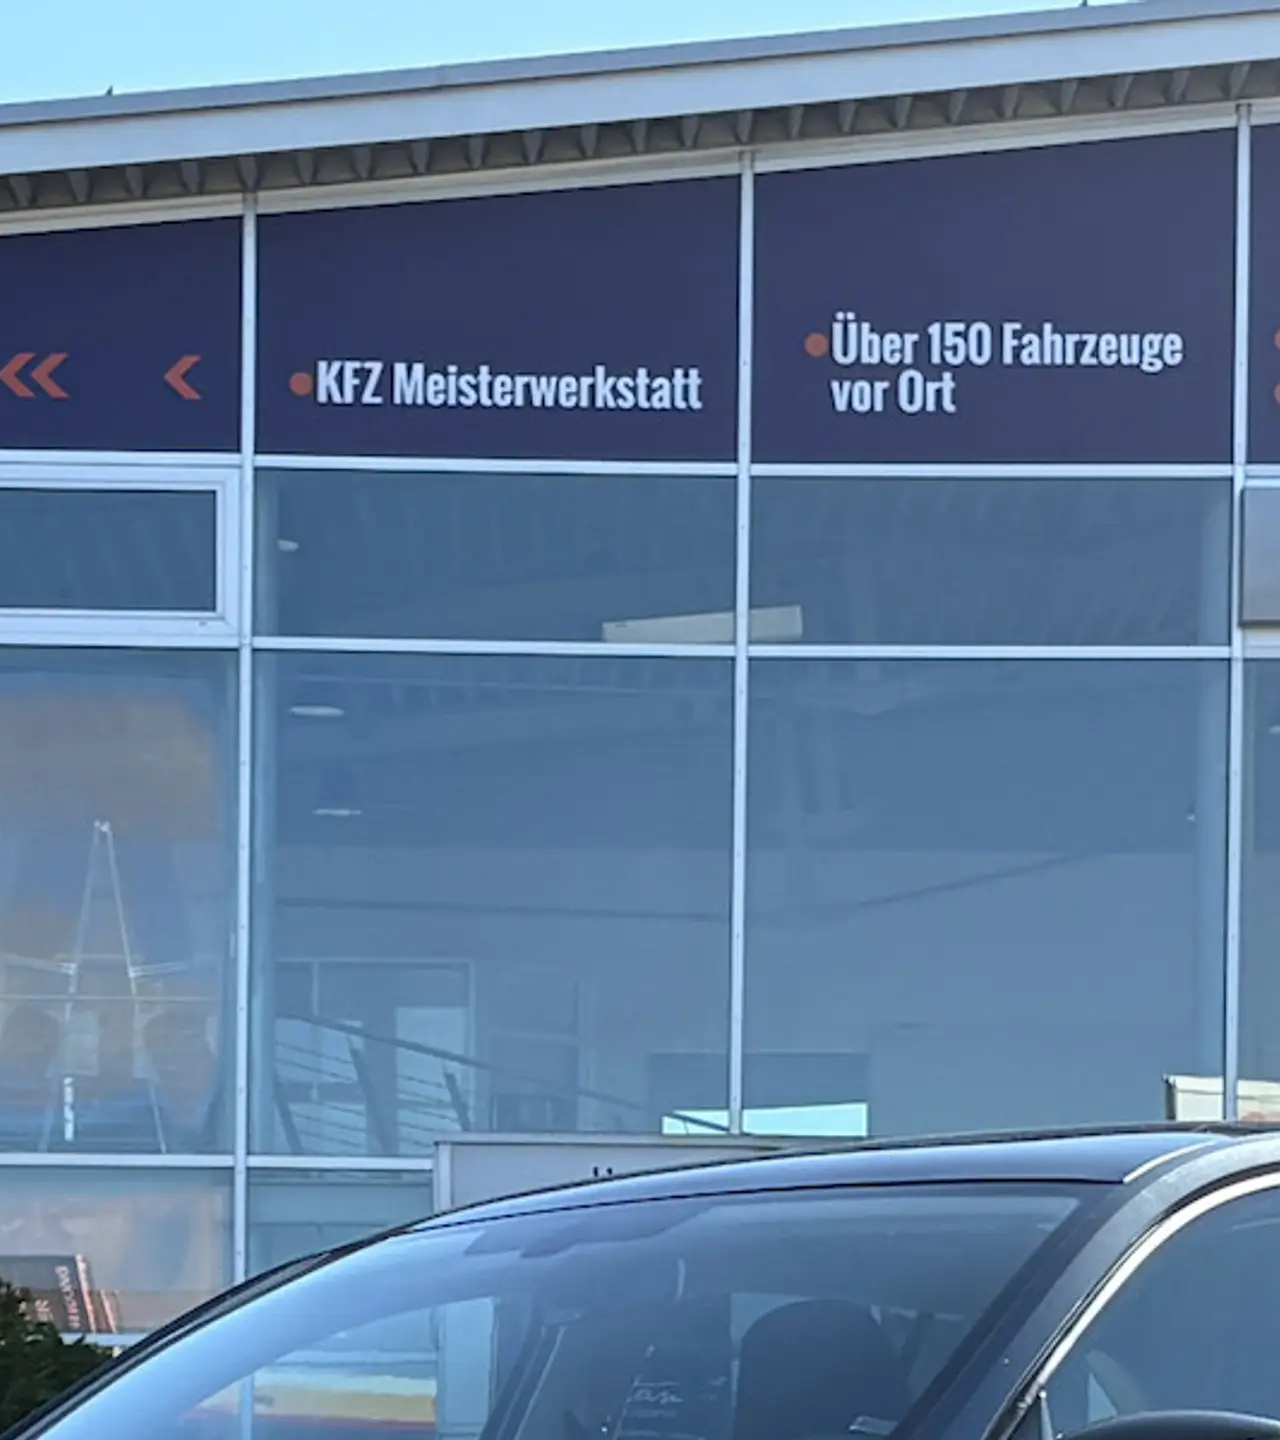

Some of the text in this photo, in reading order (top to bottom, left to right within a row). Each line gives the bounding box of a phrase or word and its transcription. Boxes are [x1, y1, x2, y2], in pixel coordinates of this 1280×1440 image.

[832, 312, 1183, 373] Über 150 Fahrzeuge
[317, 360, 703, 411] KFZ Meisterwerkstatt
[831, 369, 957, 414] vor Ort
